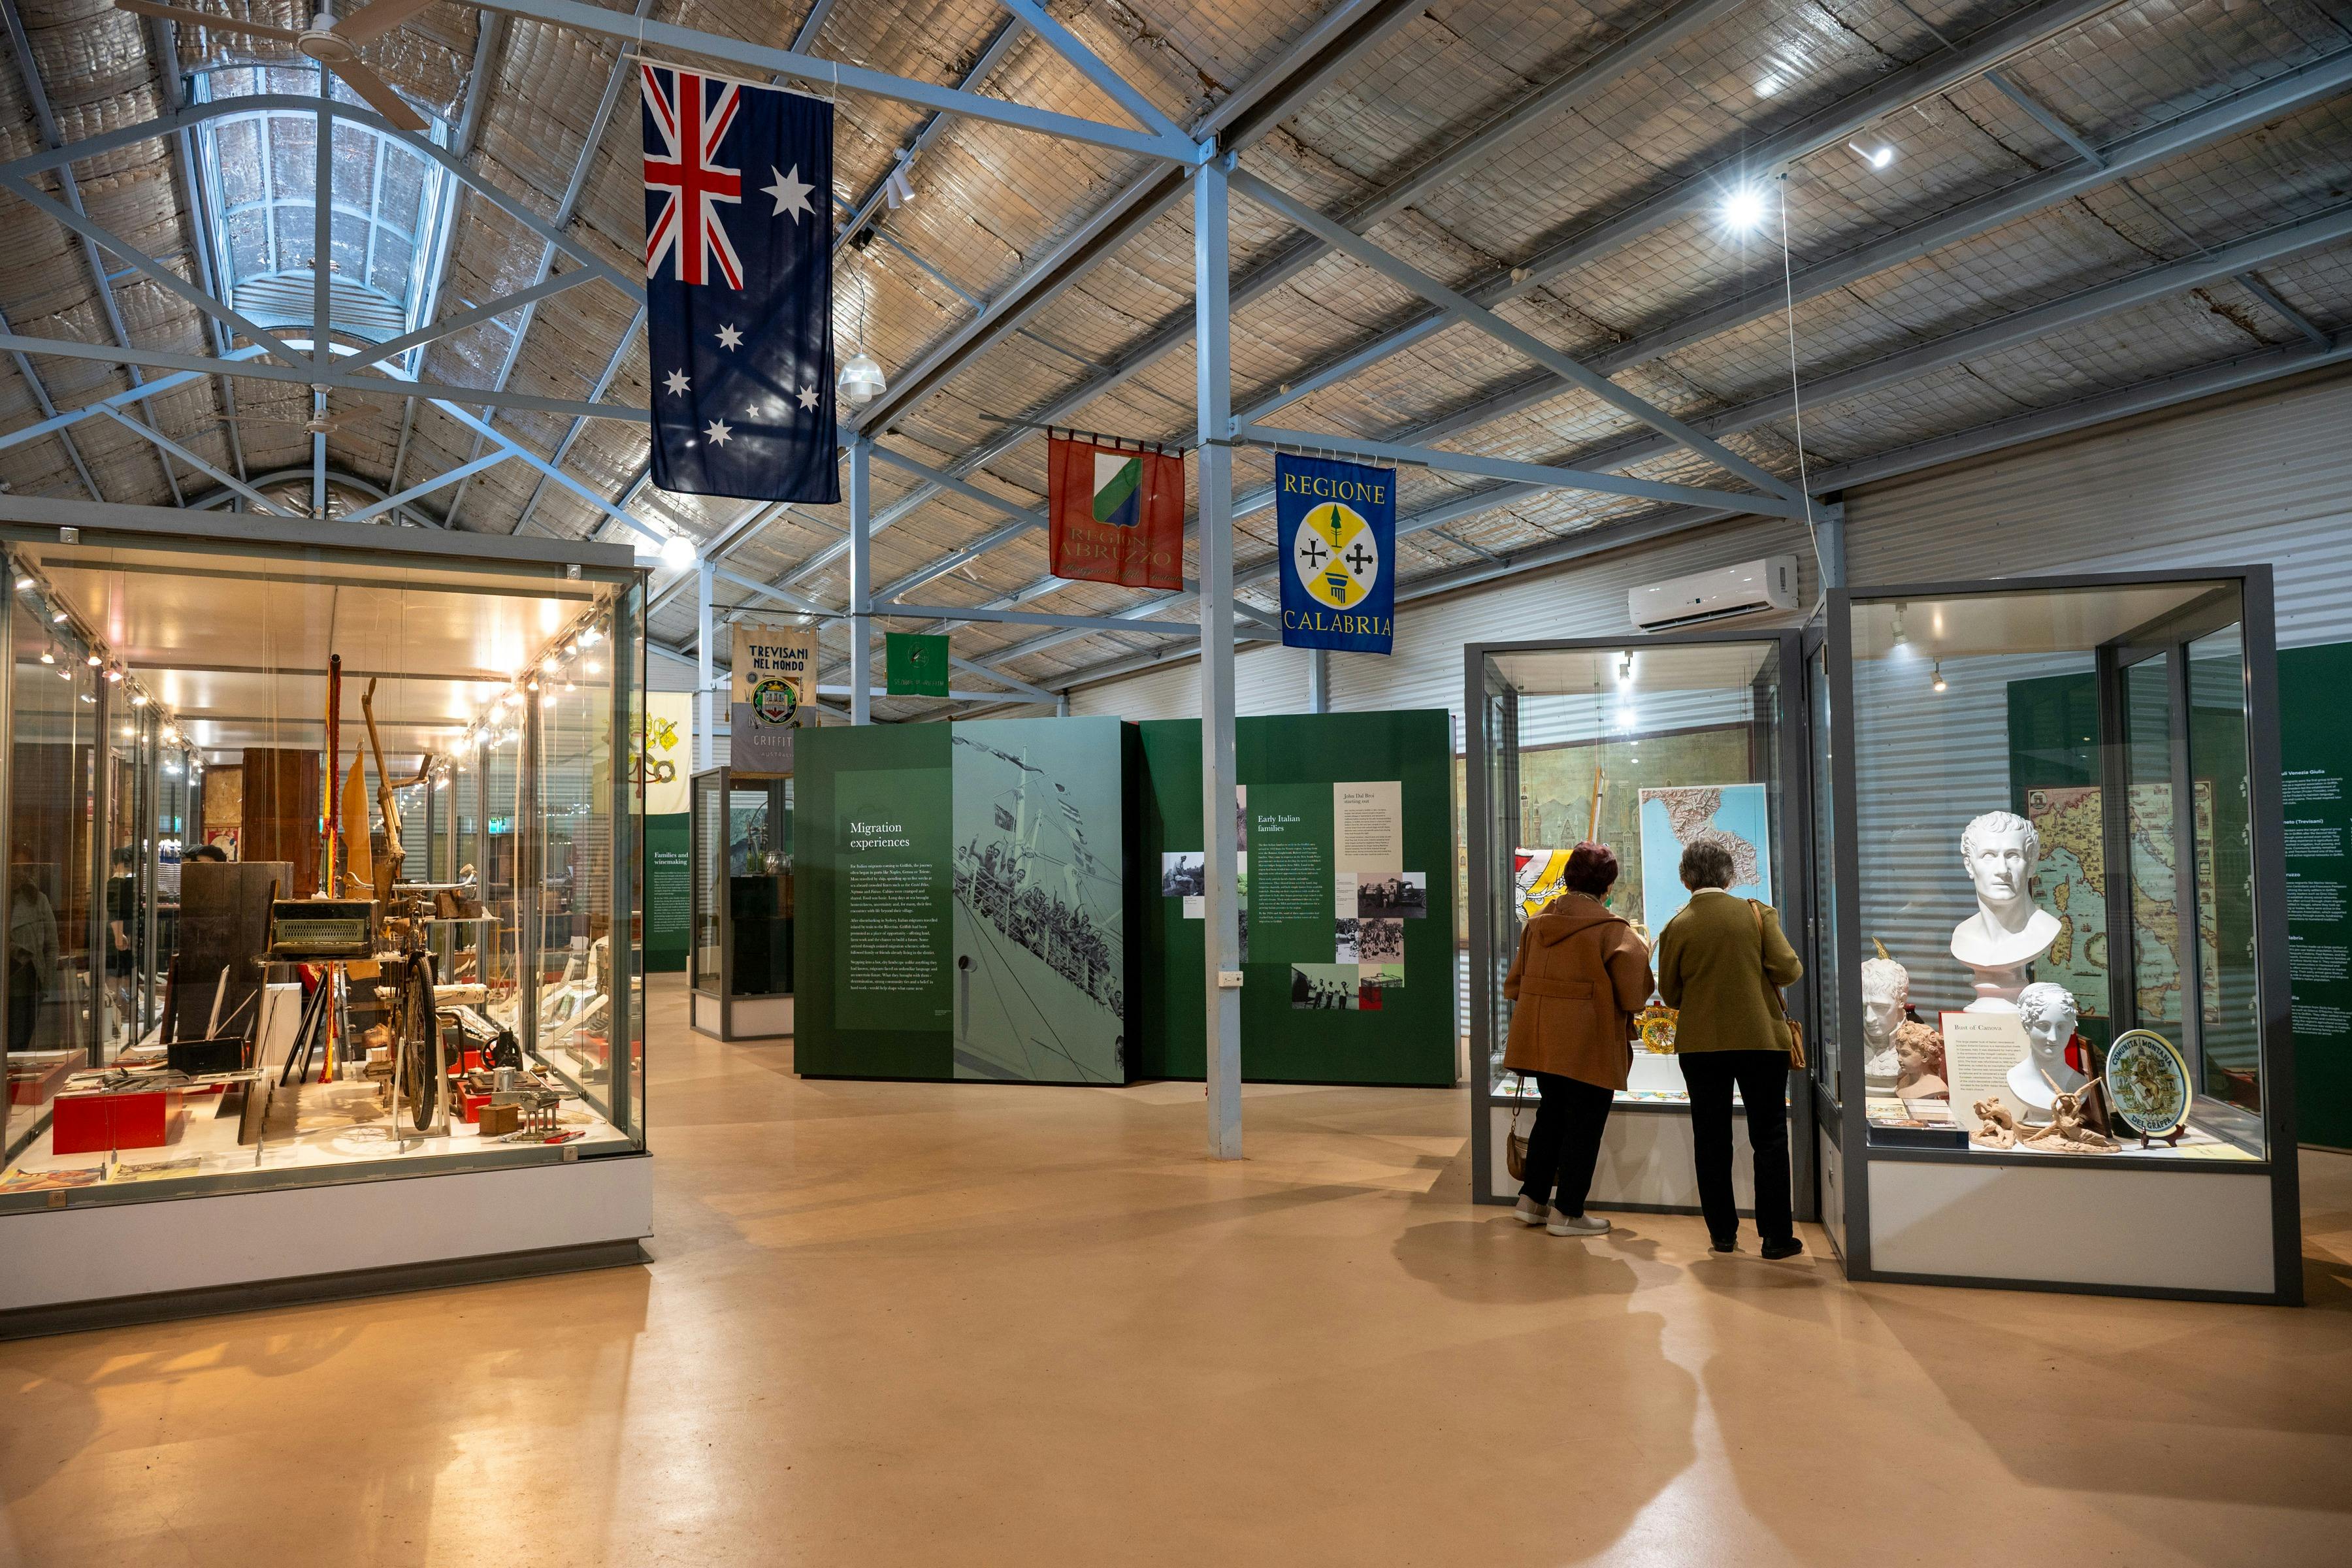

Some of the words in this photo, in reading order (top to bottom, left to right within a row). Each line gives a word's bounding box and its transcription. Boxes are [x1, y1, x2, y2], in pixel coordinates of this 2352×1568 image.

[1284, 473, 1385, 504] REGIONE
[1071, 528, 1156, 547] REGIONE
[1060, 542, 1171, 566] ABRUZZO
[1284, 610, 1391, 636] CALABRIA
[749, 645, 808, 660] TREVISANI
[754, 658, 770, 669] NEL
[774, 659, 804, 671] MONDO
[753, 735, 792, 747] GRIFFIT
[1258, 815, 1276, 824] Early
[850, 822, 902, 836] Migration
[850, 837, 909, 850] experiences
[2142, 1039, 2173, 1068] MONTANA
[2132, 1115, 2146, 1127] DEL
[2147, 1117, 2172, 1130] GRAPPA
